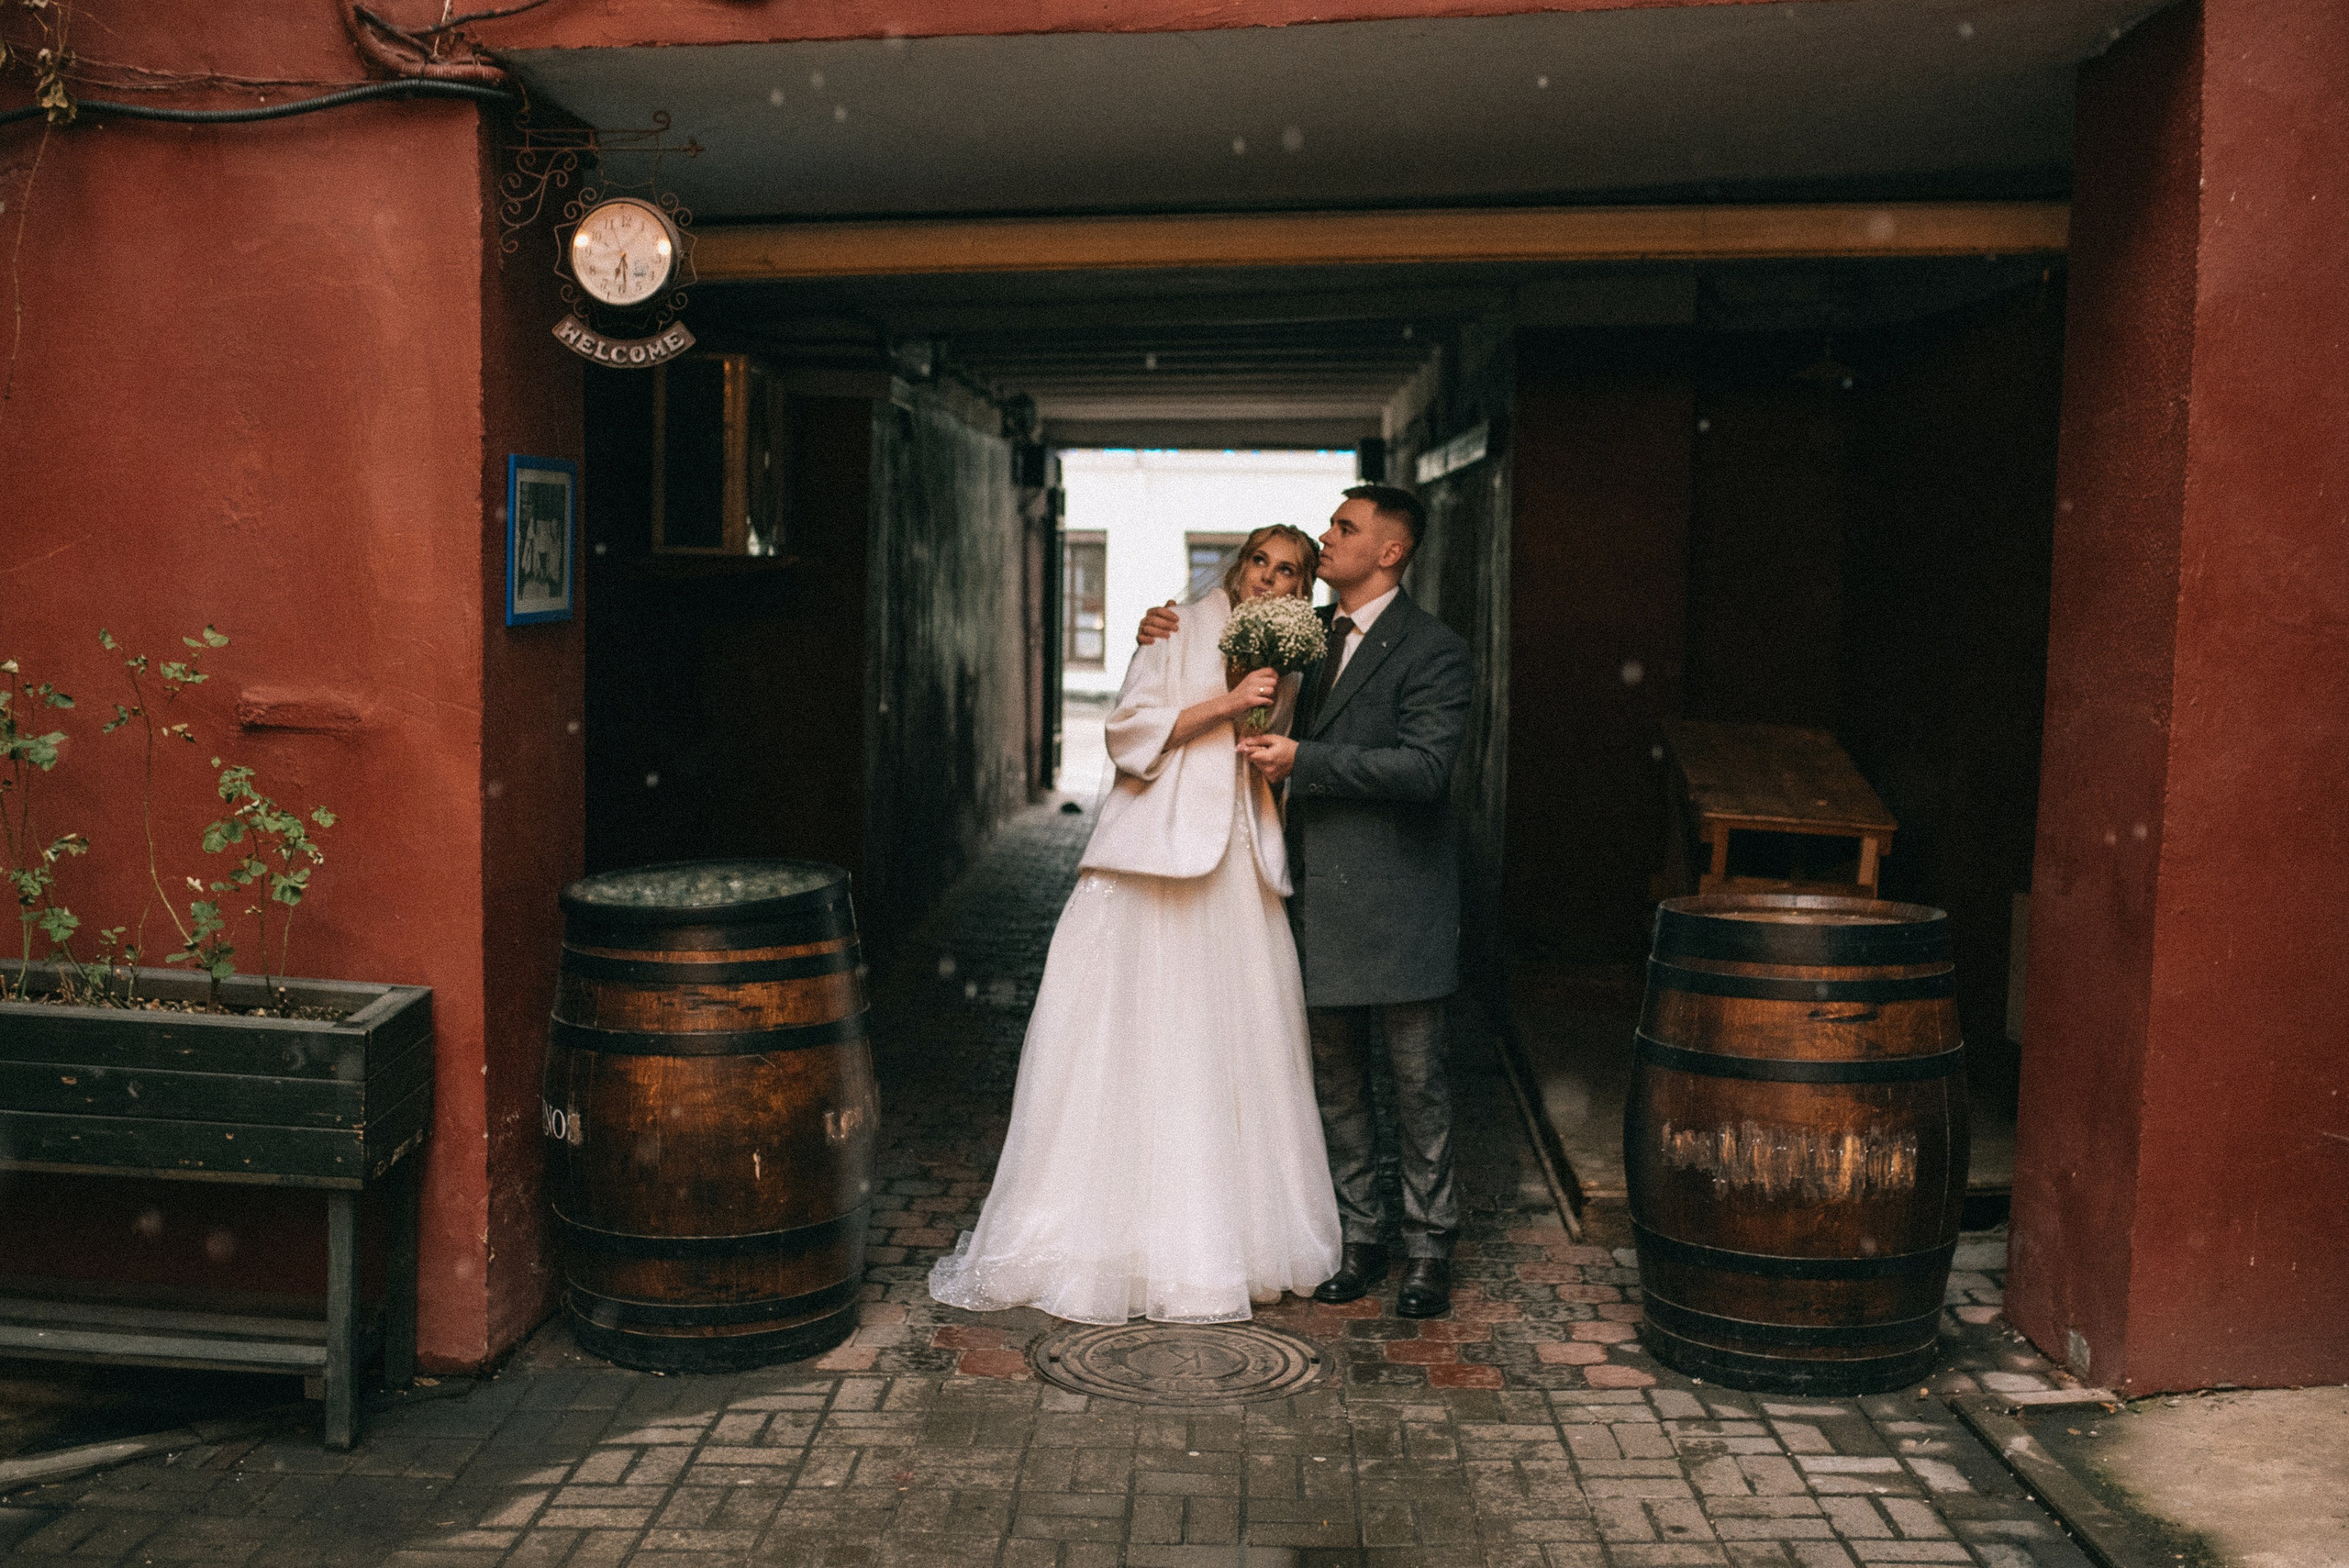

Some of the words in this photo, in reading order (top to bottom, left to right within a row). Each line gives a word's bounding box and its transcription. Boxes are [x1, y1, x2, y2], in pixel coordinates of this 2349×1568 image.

[604, 217, 615, 229] 11
[620, 215, 632, 228] 12
[592, 231, 602, 242] 10
[589, 265, 596, 275] 8
[635, 280, 642, 291] 5
[560, 321, 685, 363] WELCOME
